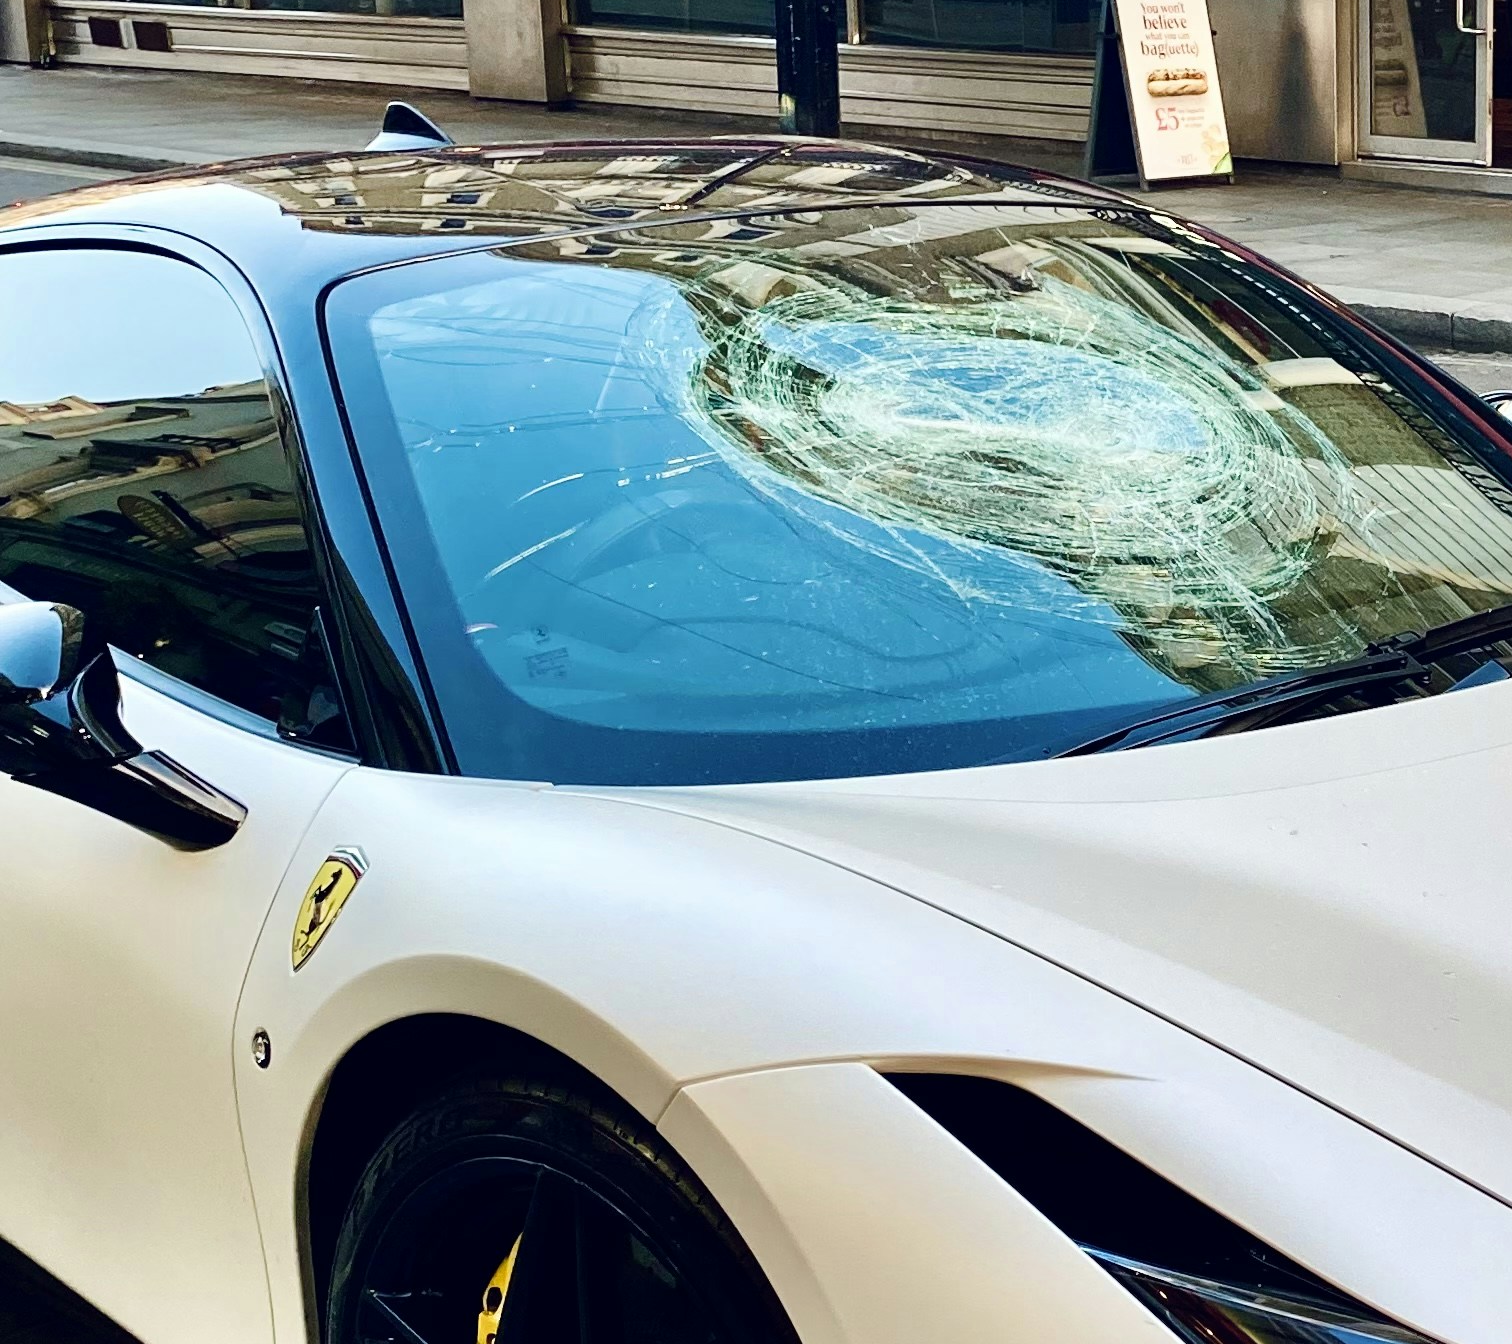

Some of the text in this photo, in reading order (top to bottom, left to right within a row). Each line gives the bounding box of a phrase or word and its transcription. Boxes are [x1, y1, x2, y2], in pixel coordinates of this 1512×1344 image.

[1140, 1, 1186, 14] You won't
[1143, 15, 1188, 30] believe
[1140, 40, 1199, 59] bag(uette)
[1155, 107, 1180, 131] £5
